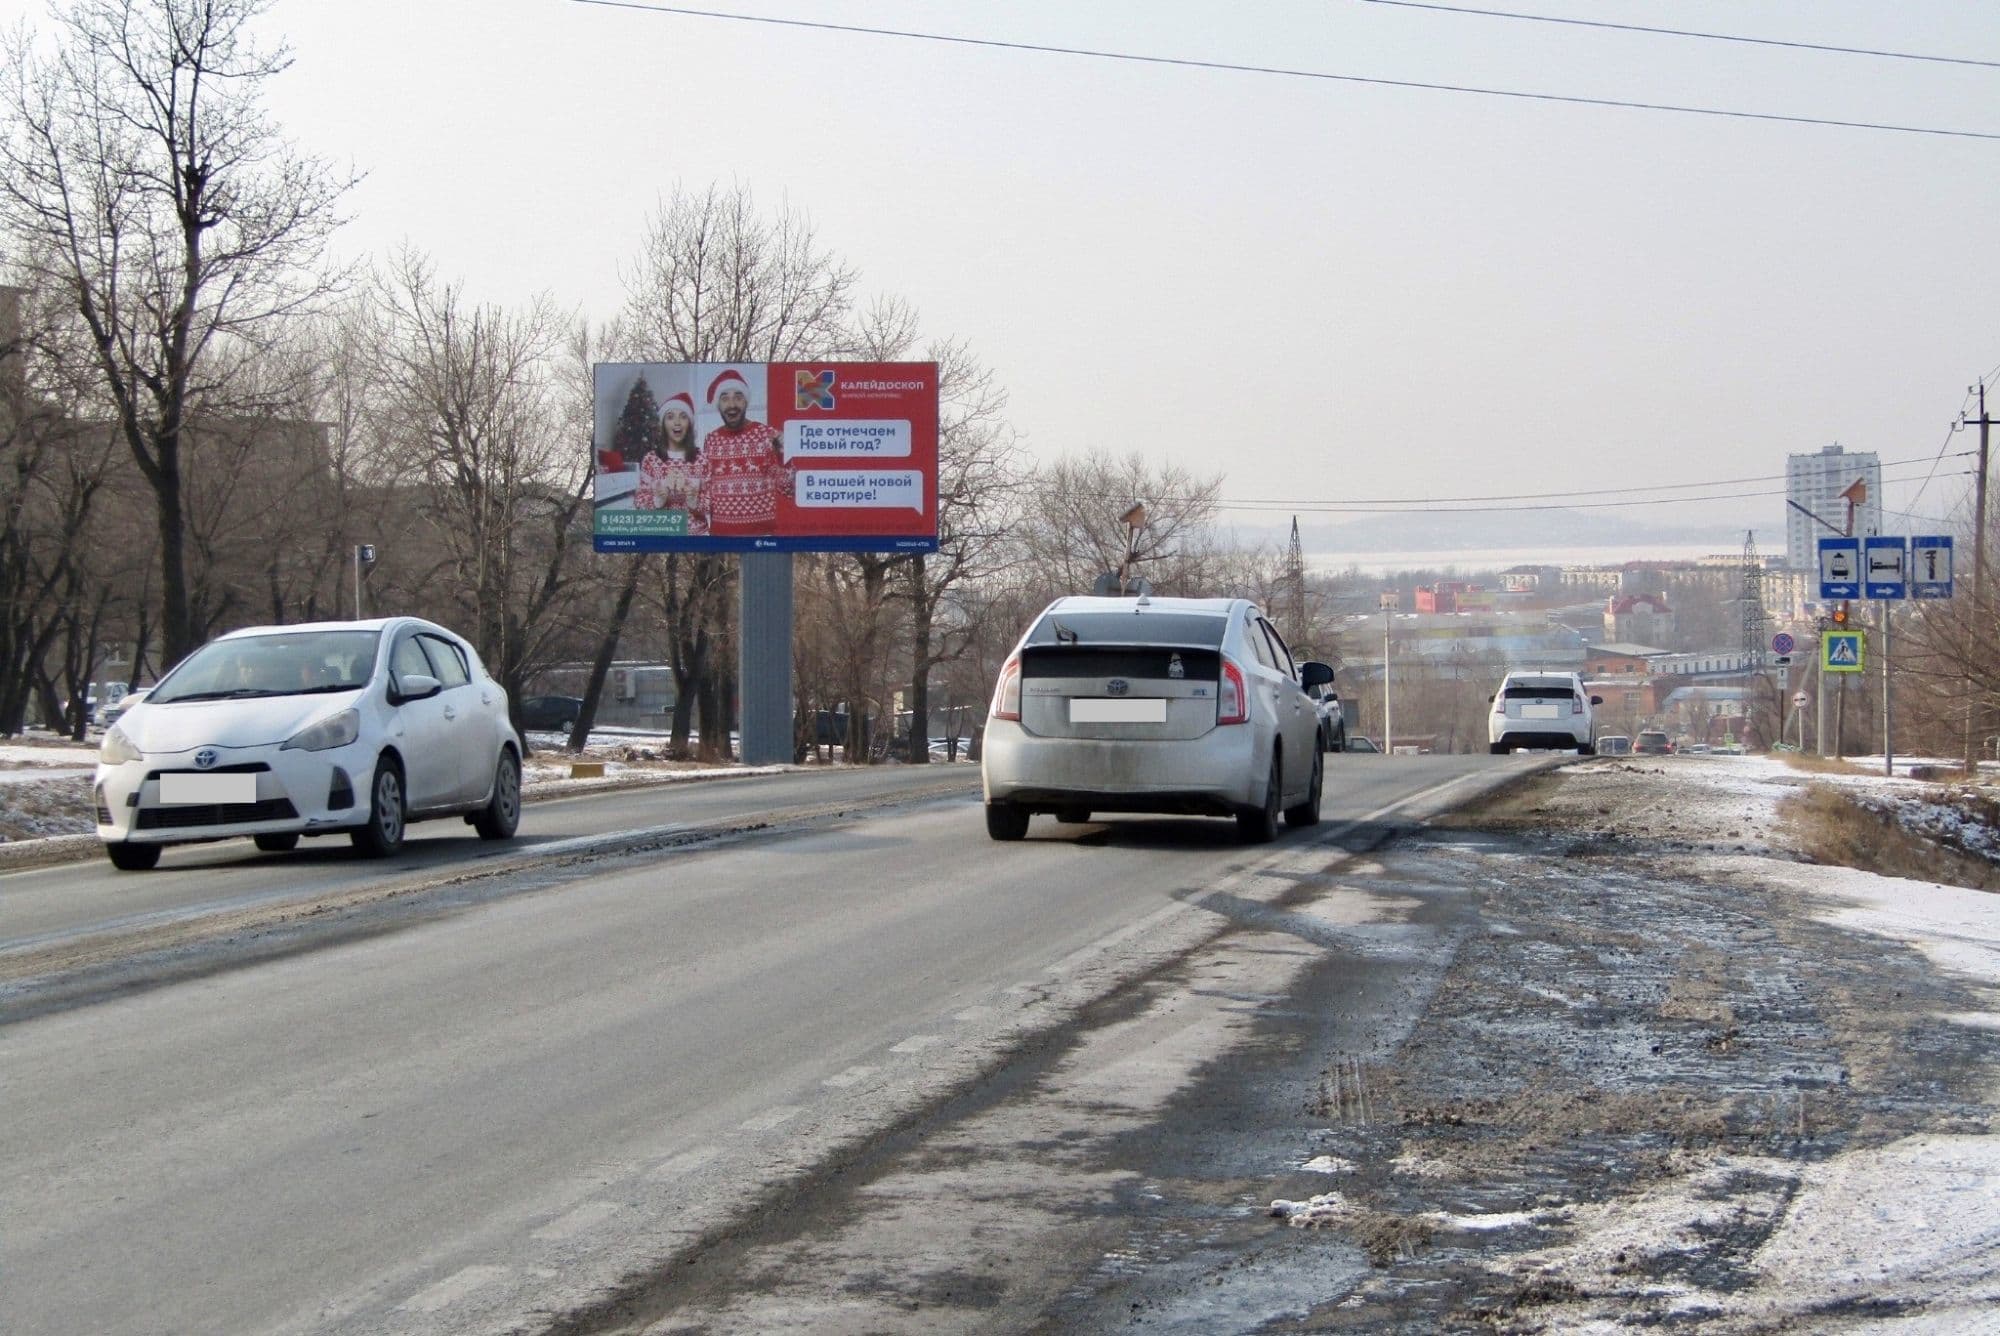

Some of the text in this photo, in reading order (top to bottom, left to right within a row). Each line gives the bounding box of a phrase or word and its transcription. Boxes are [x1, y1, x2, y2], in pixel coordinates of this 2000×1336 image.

[840, 380, 924, 391] КАЛЕЙДОСКОП
[800, 425, 896, 437] Где отмечаем
[800, 438, 881, 451] Новый год?
[806, 475, 912, 487] В нашей новой
[806, 489, 877, 502] квартире!
[601, 515, 608, 524] 8
[609, 514, 634, 525] (423)
